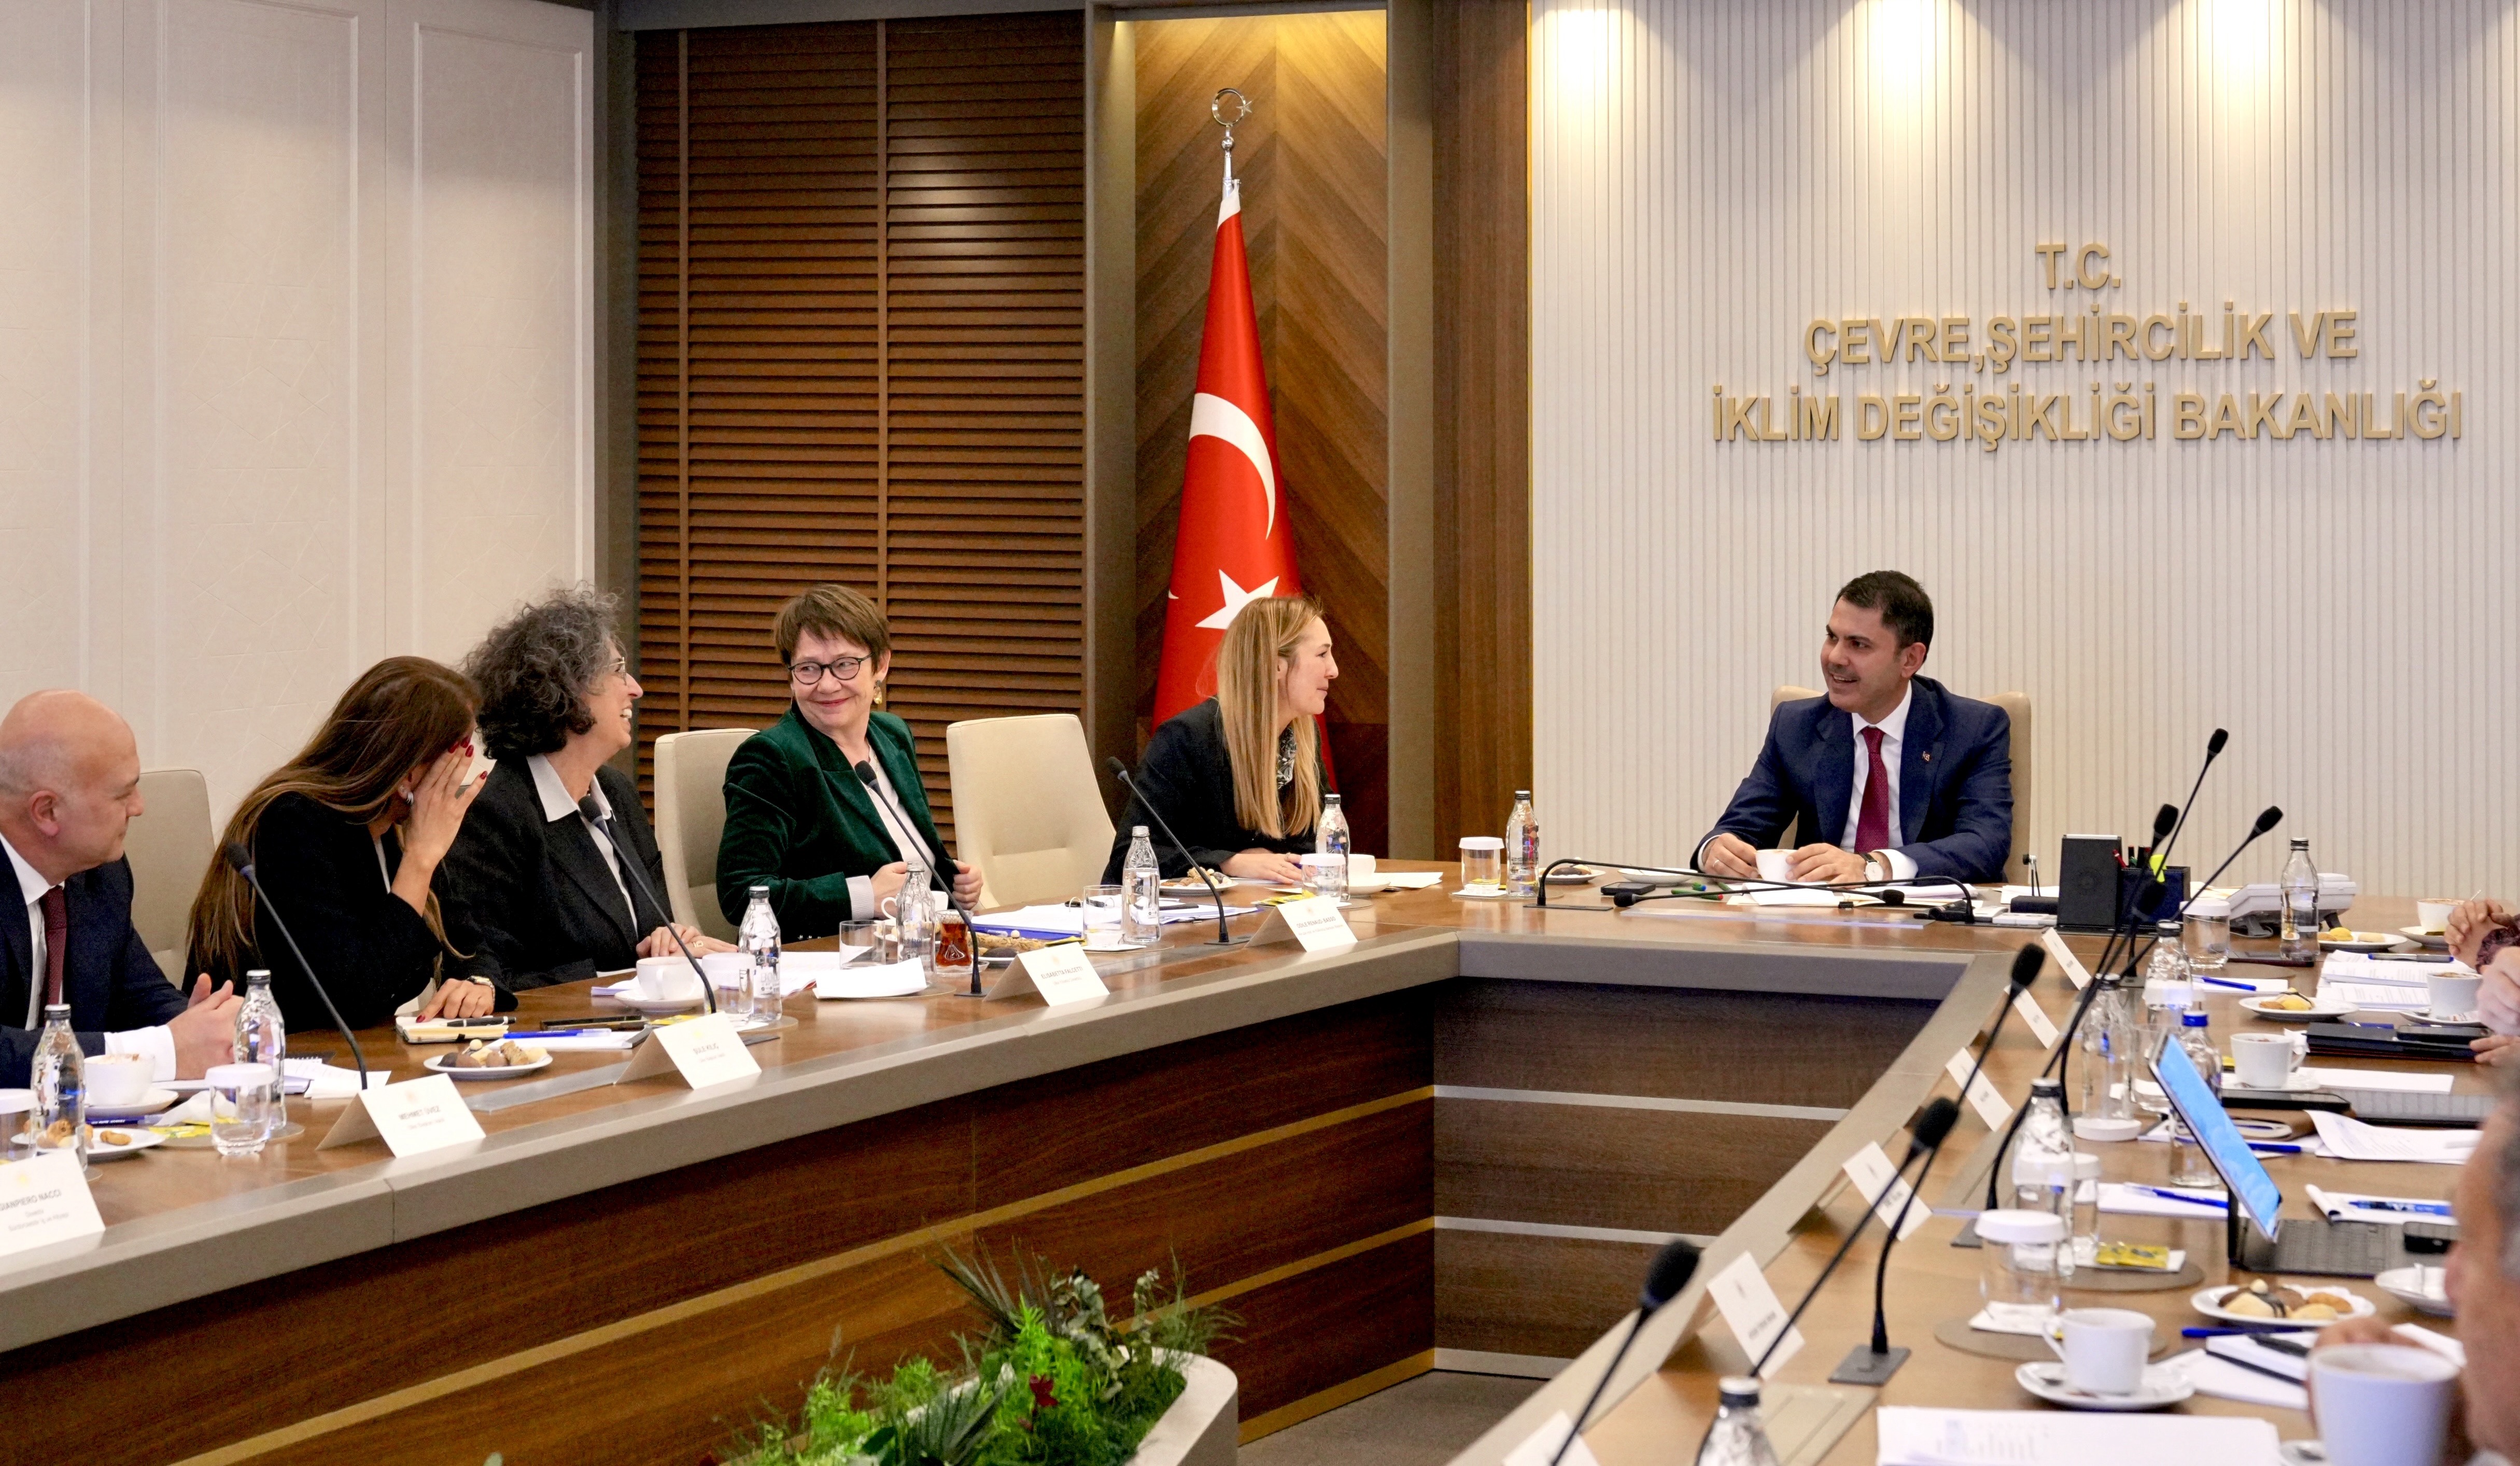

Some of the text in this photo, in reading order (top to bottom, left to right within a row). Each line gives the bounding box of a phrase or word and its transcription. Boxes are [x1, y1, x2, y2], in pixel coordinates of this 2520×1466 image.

[2035, 243, 2121, 289] T.C.
[2288, 311, 2358, 358] VE
[1712, 379, 2461, 452] İKLİM DEĞİŞİKLİĞİ BAKANLIĞI
[1040, 966, 1083, 979] ELISABETTA FALCETTI
